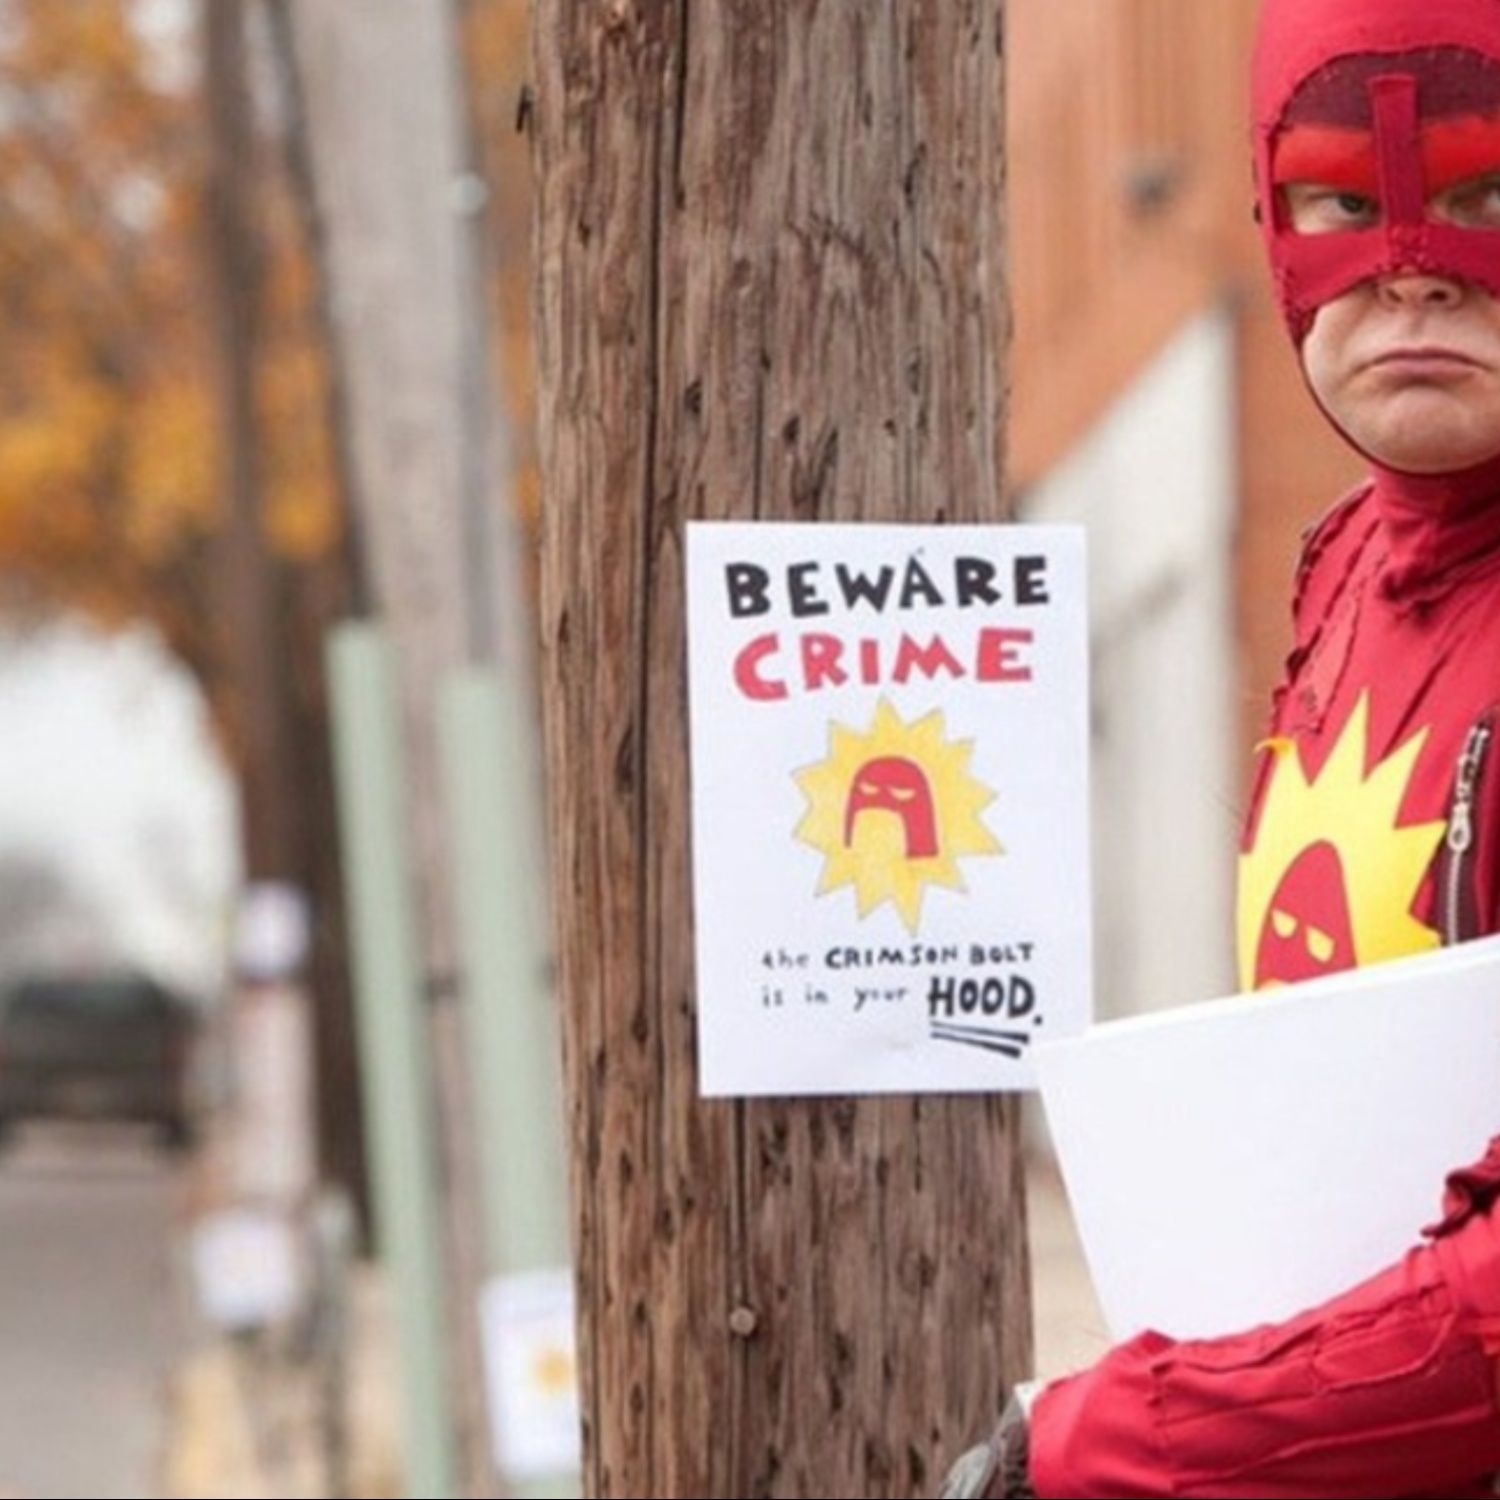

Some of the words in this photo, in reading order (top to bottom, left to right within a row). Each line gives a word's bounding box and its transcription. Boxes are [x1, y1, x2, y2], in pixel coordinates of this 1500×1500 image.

[724, 554, 1051, 619] BEWARE
[732, 626, 1035, 702] CRIME
[761, 949, 809, 970] the
[824, 943, 959, 970] CRIMSON
[969, 942, 1034, 966] BOLT
[762, 985, 784, 1007] is
[805, 984, 829, 1004] in
[853, 987, 908, 1012] your
